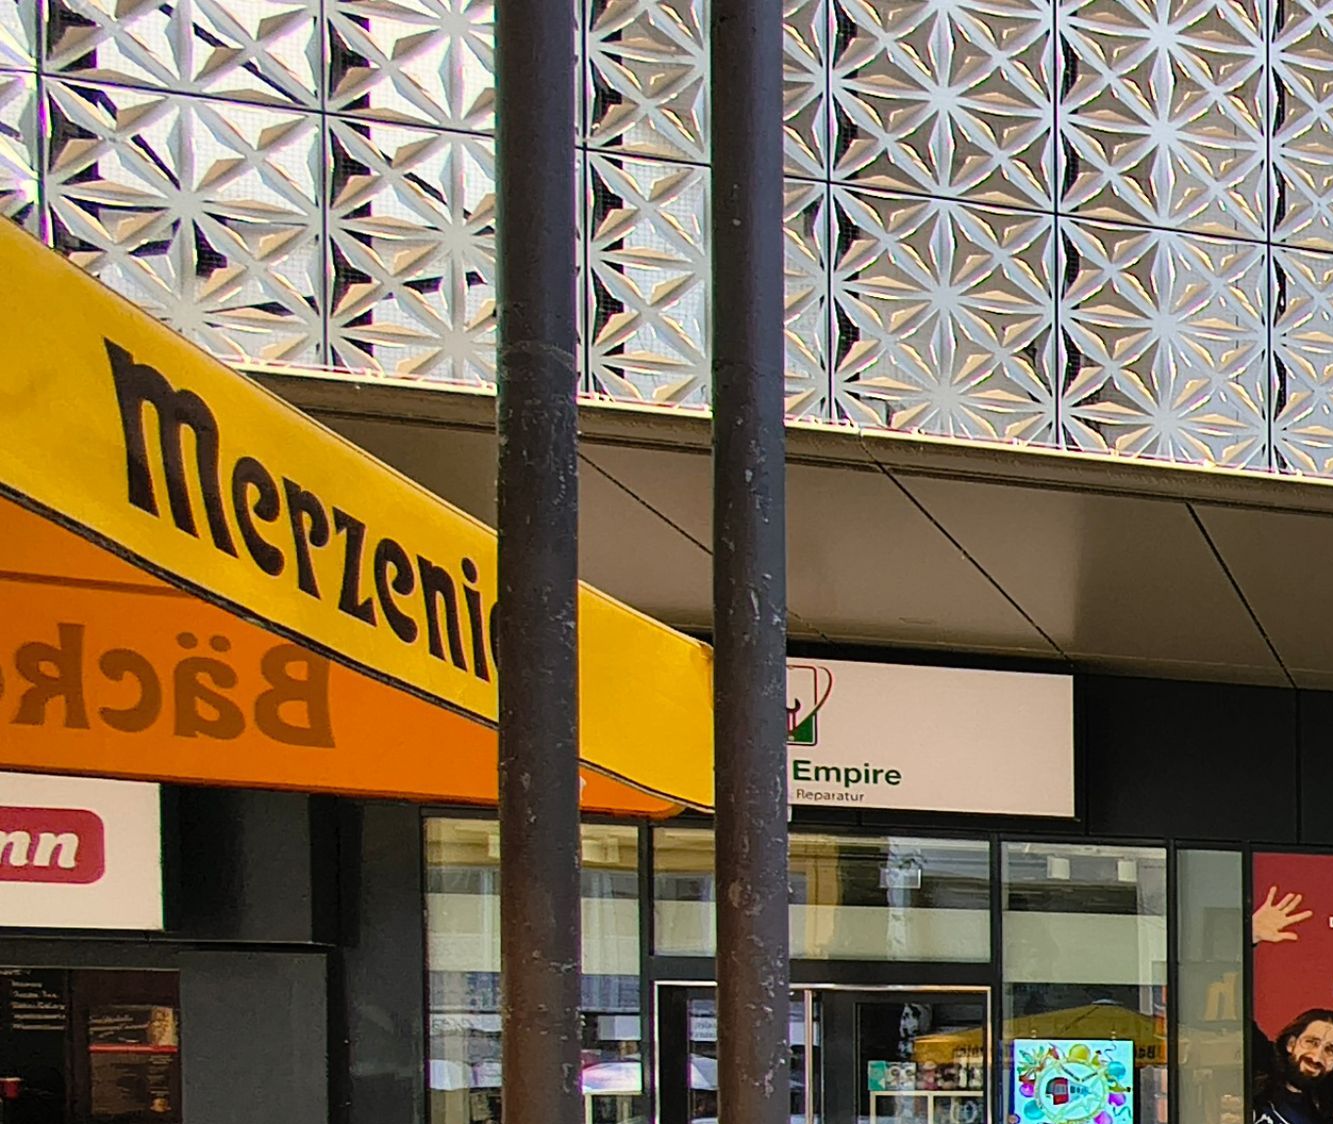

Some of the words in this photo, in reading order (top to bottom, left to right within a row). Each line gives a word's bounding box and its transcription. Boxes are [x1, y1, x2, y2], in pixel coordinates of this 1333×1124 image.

[104, 337, 498, 683] Merzeni
[792, 759, 902, 788] Empire
[796, 788, 864, 802] Reparatur
